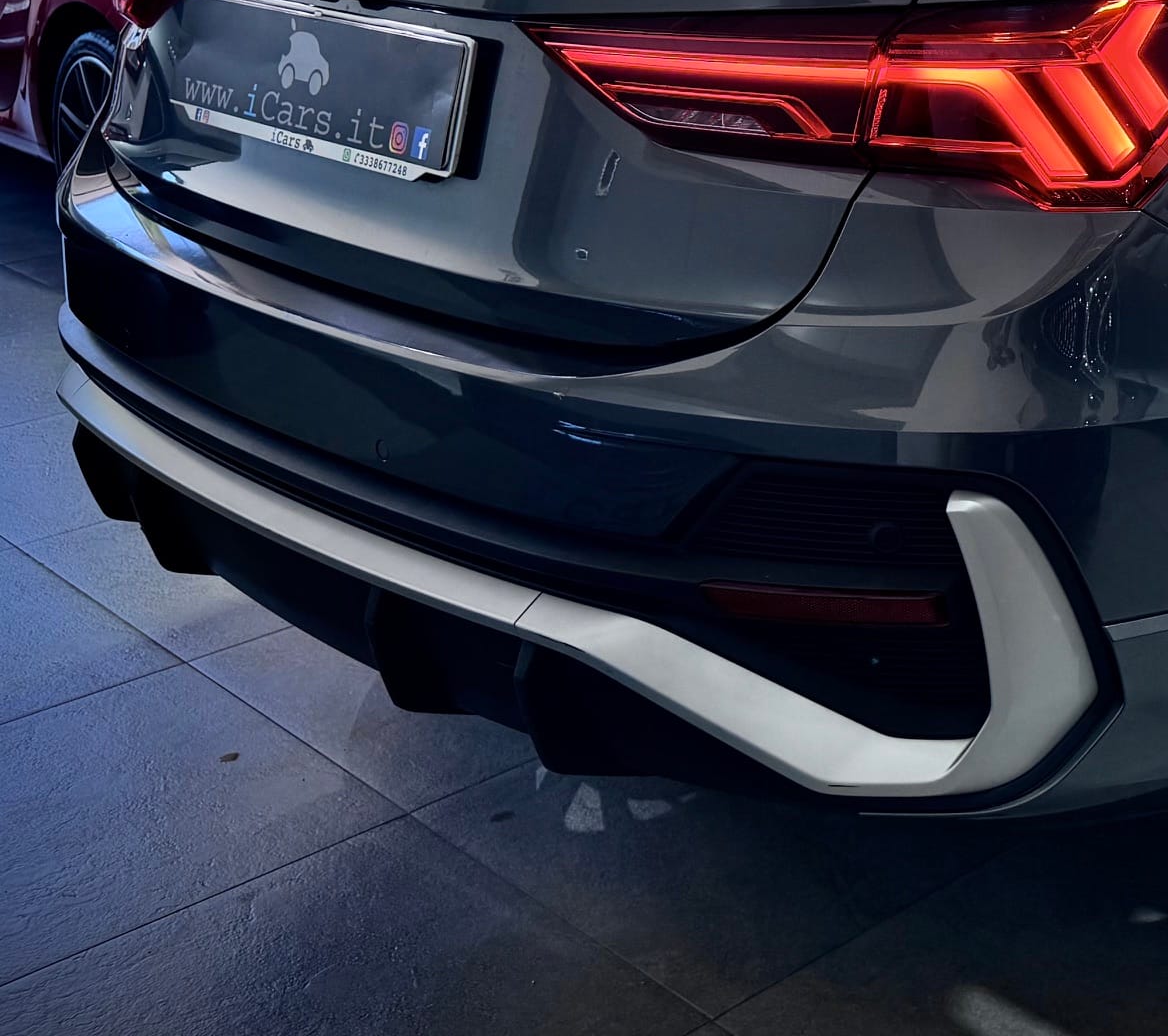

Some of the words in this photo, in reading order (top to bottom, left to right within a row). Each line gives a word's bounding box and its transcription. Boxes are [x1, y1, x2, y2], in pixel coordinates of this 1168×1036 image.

[184, 77, 384, 149] www.iCars.it
[271, 127, 301, 149] iCars
[360, 154, 408, 177] 3338677248
